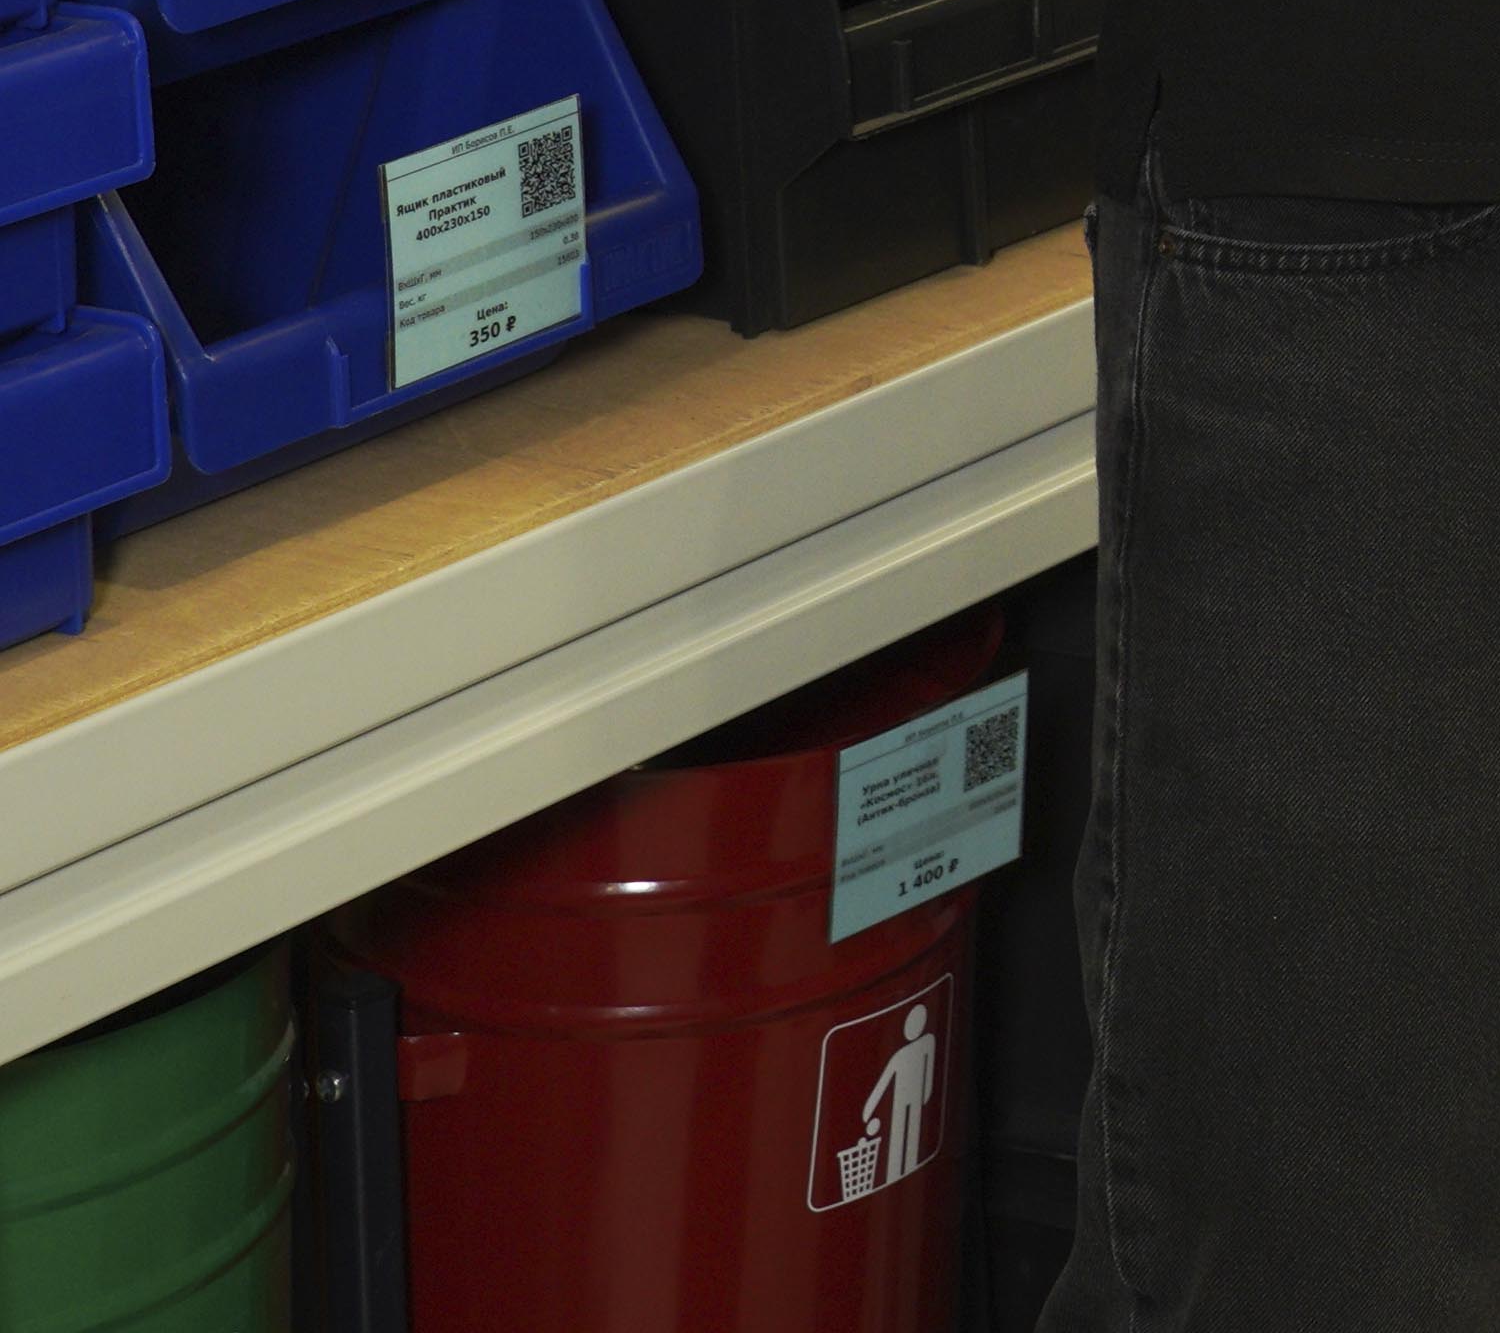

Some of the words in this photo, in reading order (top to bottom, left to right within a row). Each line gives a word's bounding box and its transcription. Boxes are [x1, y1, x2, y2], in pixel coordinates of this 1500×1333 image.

[396, 195, 429, 218] Ящик
[431, 165, 507, 205] пластиковый
[428, 195, 478, 223] Практик
[476, 300, 509, 322] Цена:
[469, 321, 501, 348] 350
[862, 778, 890, 796] Урна
[892, 756, 939, 785] уличная
[913, 850, 945, 870] Цена:
[897, 880, 909, 897] 1
[912, 864, 944, 888] 400
